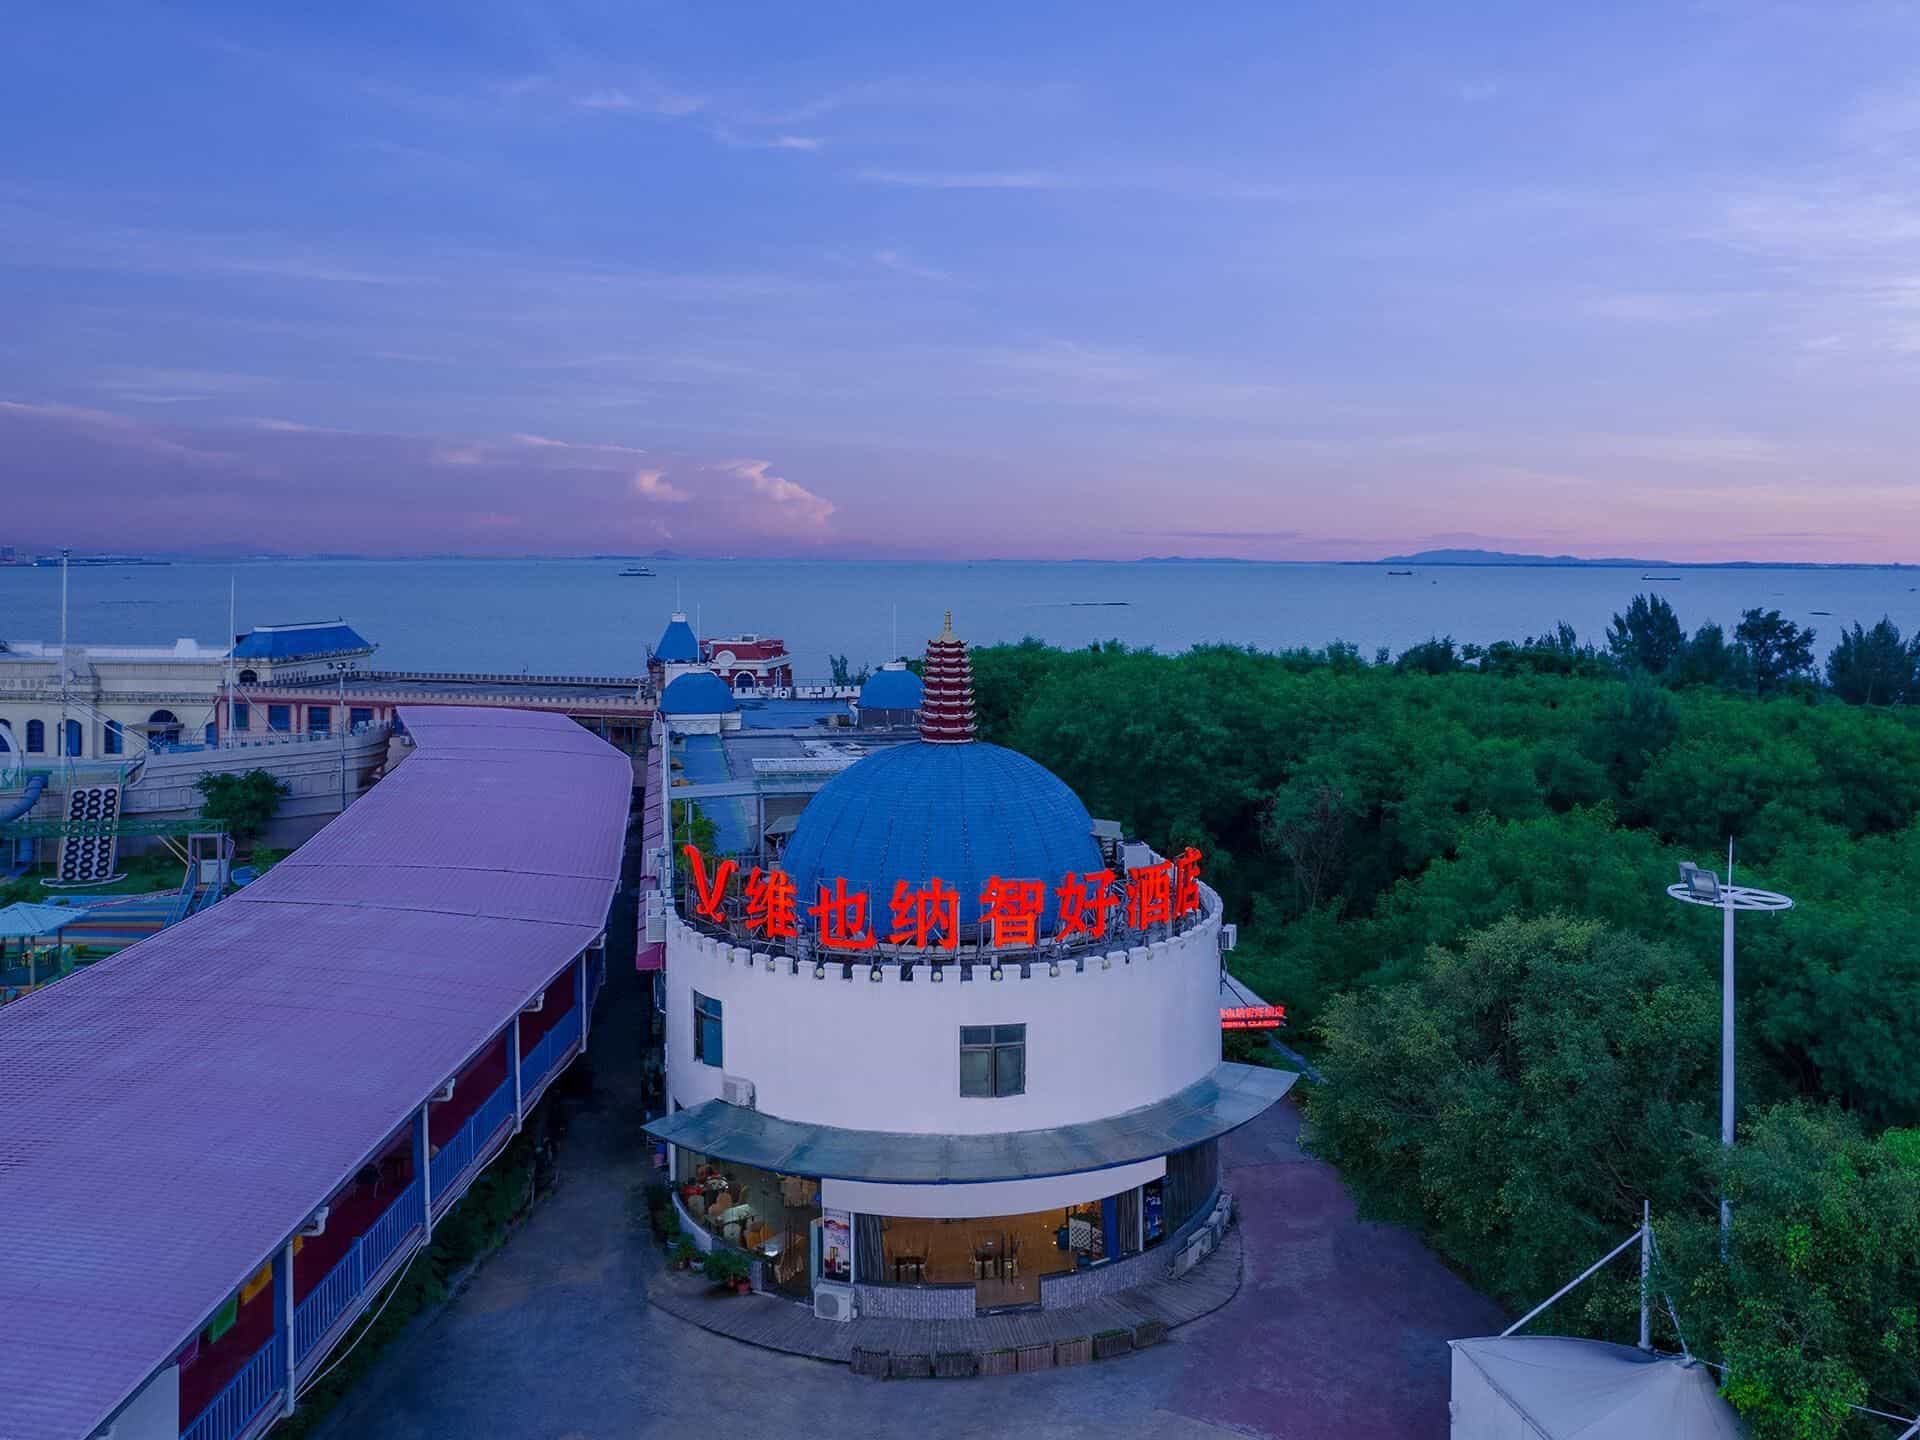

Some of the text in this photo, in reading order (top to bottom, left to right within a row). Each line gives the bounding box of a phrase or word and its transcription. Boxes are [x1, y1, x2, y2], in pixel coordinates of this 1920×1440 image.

[744, 846, 1203, 951] 维也纳智好酒店
